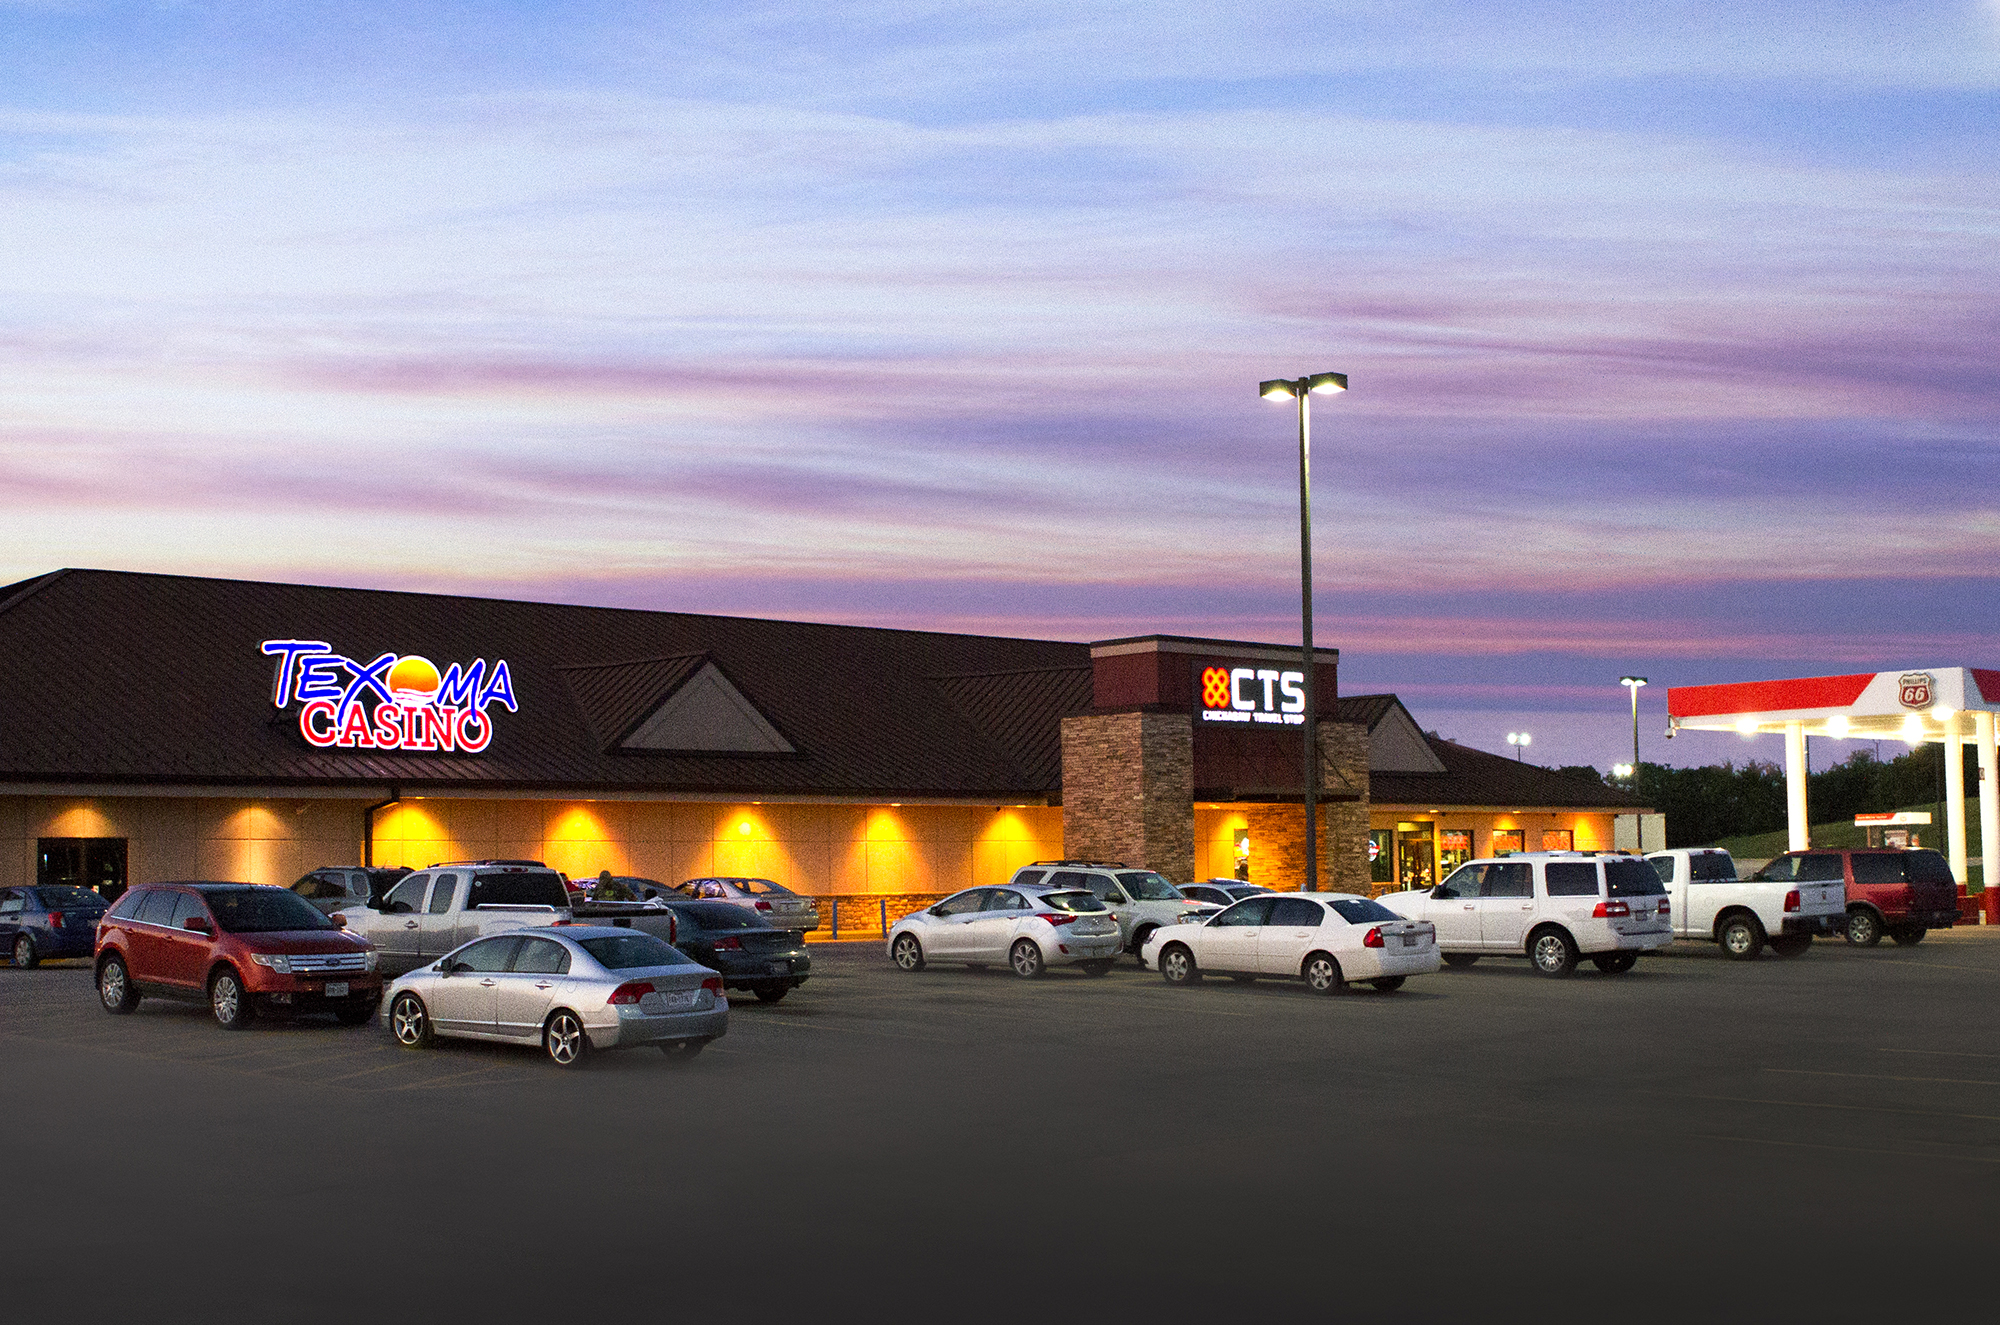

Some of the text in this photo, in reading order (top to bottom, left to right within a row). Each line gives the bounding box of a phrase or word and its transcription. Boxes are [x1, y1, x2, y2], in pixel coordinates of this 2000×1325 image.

[261, 640, 519, 727] TEXOMA
[1230, 668, 1306, 713] CTS
[1904, 687, 1926, 702] 66
[300, 699, 493, 753] CASINO
